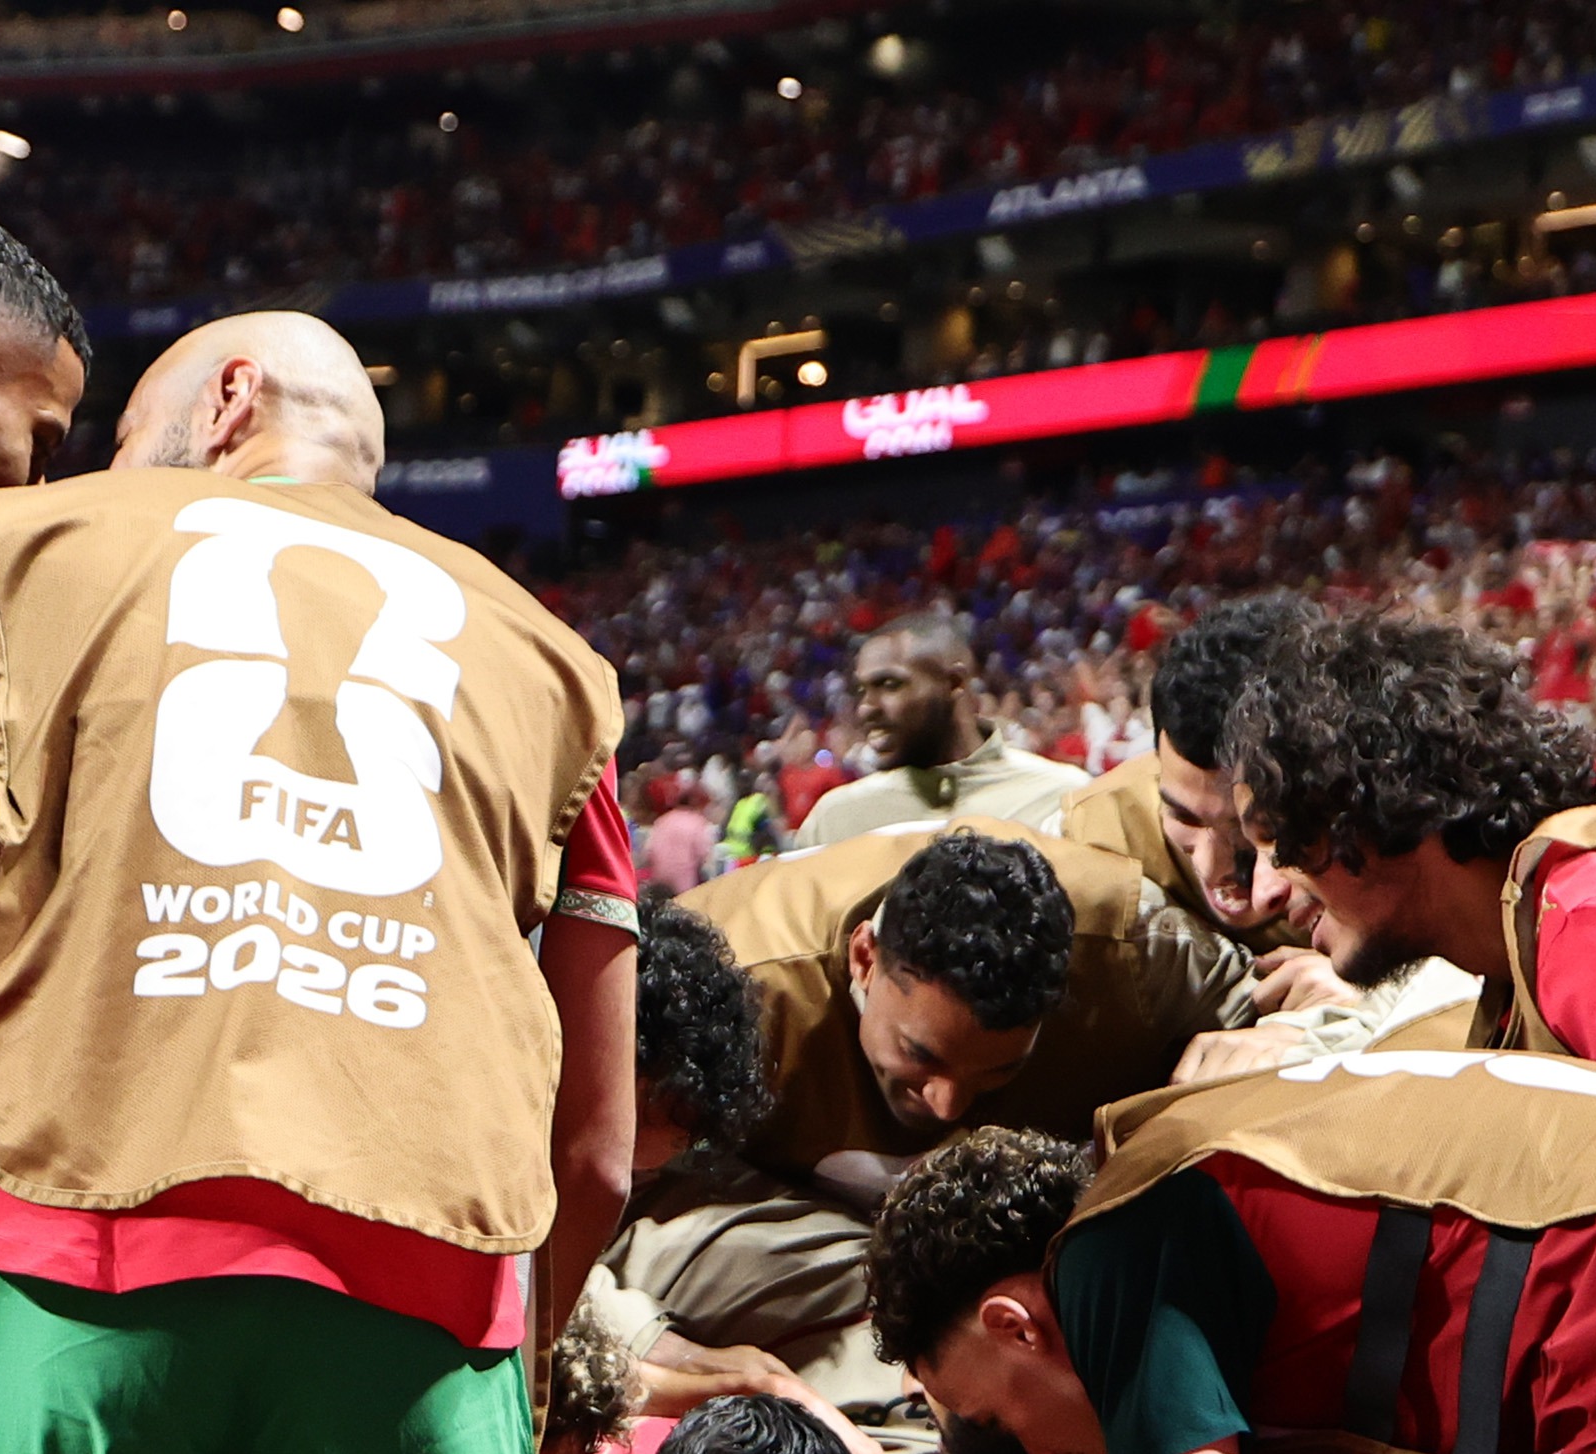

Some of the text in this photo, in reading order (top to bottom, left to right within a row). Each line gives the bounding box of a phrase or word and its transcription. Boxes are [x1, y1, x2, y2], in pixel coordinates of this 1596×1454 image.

[239, 779, 363, 852] FIFA
[141, 880, 437, 961] WORLD CUP
[133, 924, 428, 1030] 2026
